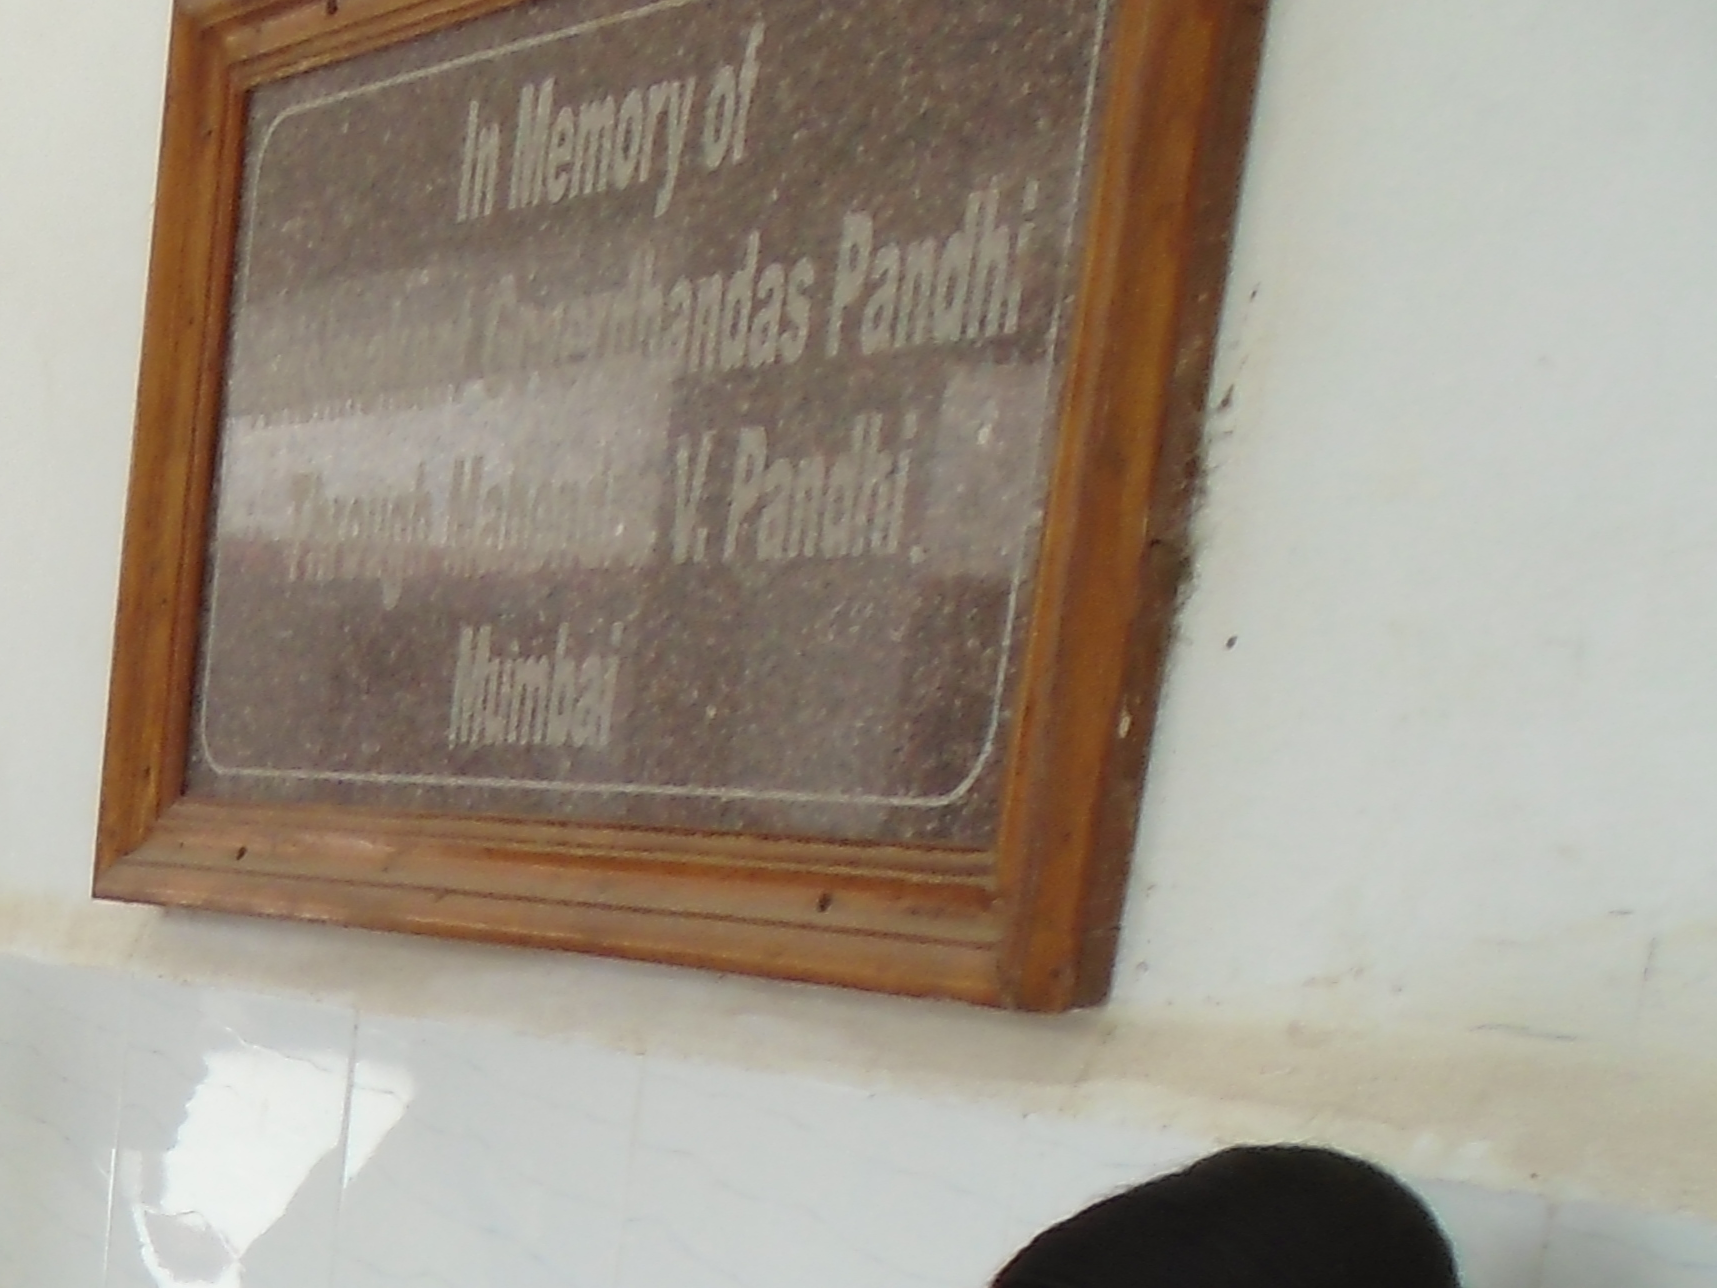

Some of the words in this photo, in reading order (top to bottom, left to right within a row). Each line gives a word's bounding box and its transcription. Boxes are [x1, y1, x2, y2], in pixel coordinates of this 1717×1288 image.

[454, 100, 501, 225] In
[509, 76, 696, 217] Memory
[702, 27, 768, 166] of
[822, 176, 1042, 363] Pandhi
[448, 619, 625, 752] Mumbai
